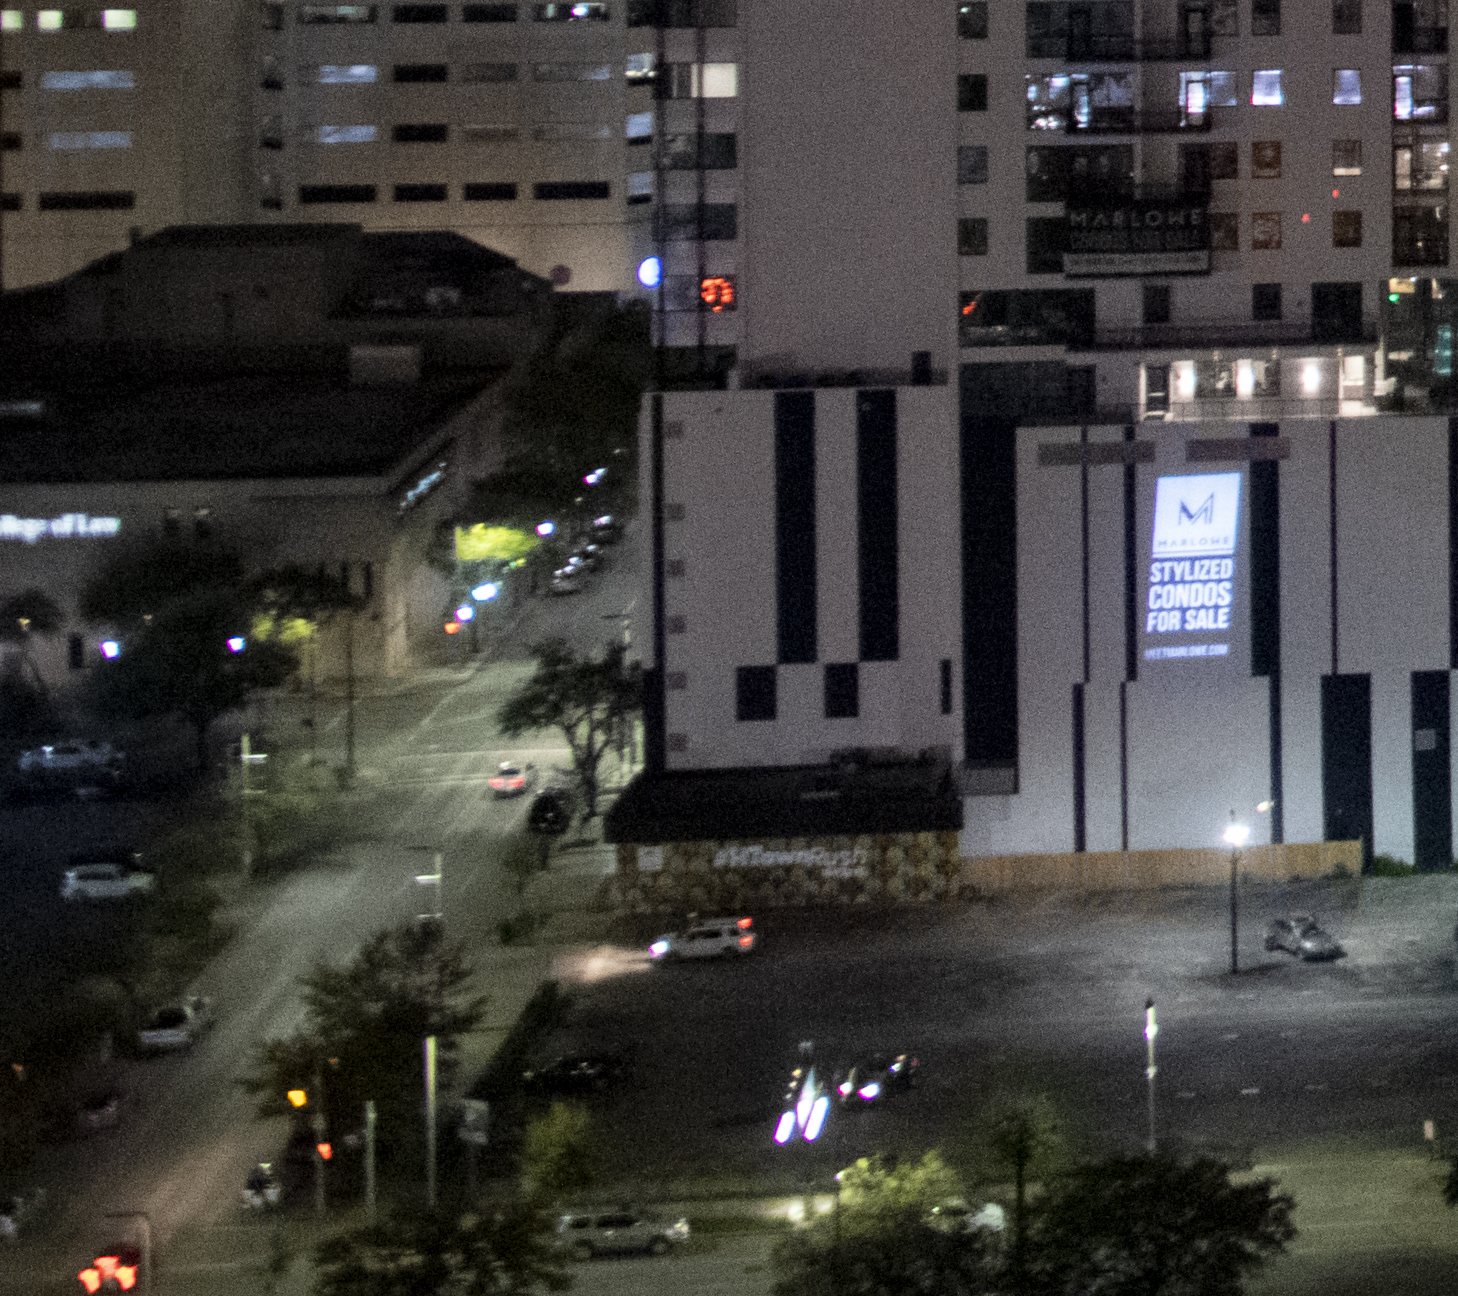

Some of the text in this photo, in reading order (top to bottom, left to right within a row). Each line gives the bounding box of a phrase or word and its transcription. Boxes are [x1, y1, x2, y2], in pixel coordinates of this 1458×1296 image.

[1157, 535, 1229, 547] MARLOWE
[1150, 558, 1233, 583] STYLIZED
[1148, 581, 1232, 609] CONDOS
[1146, 607, 1230, 632] FOR SALE
